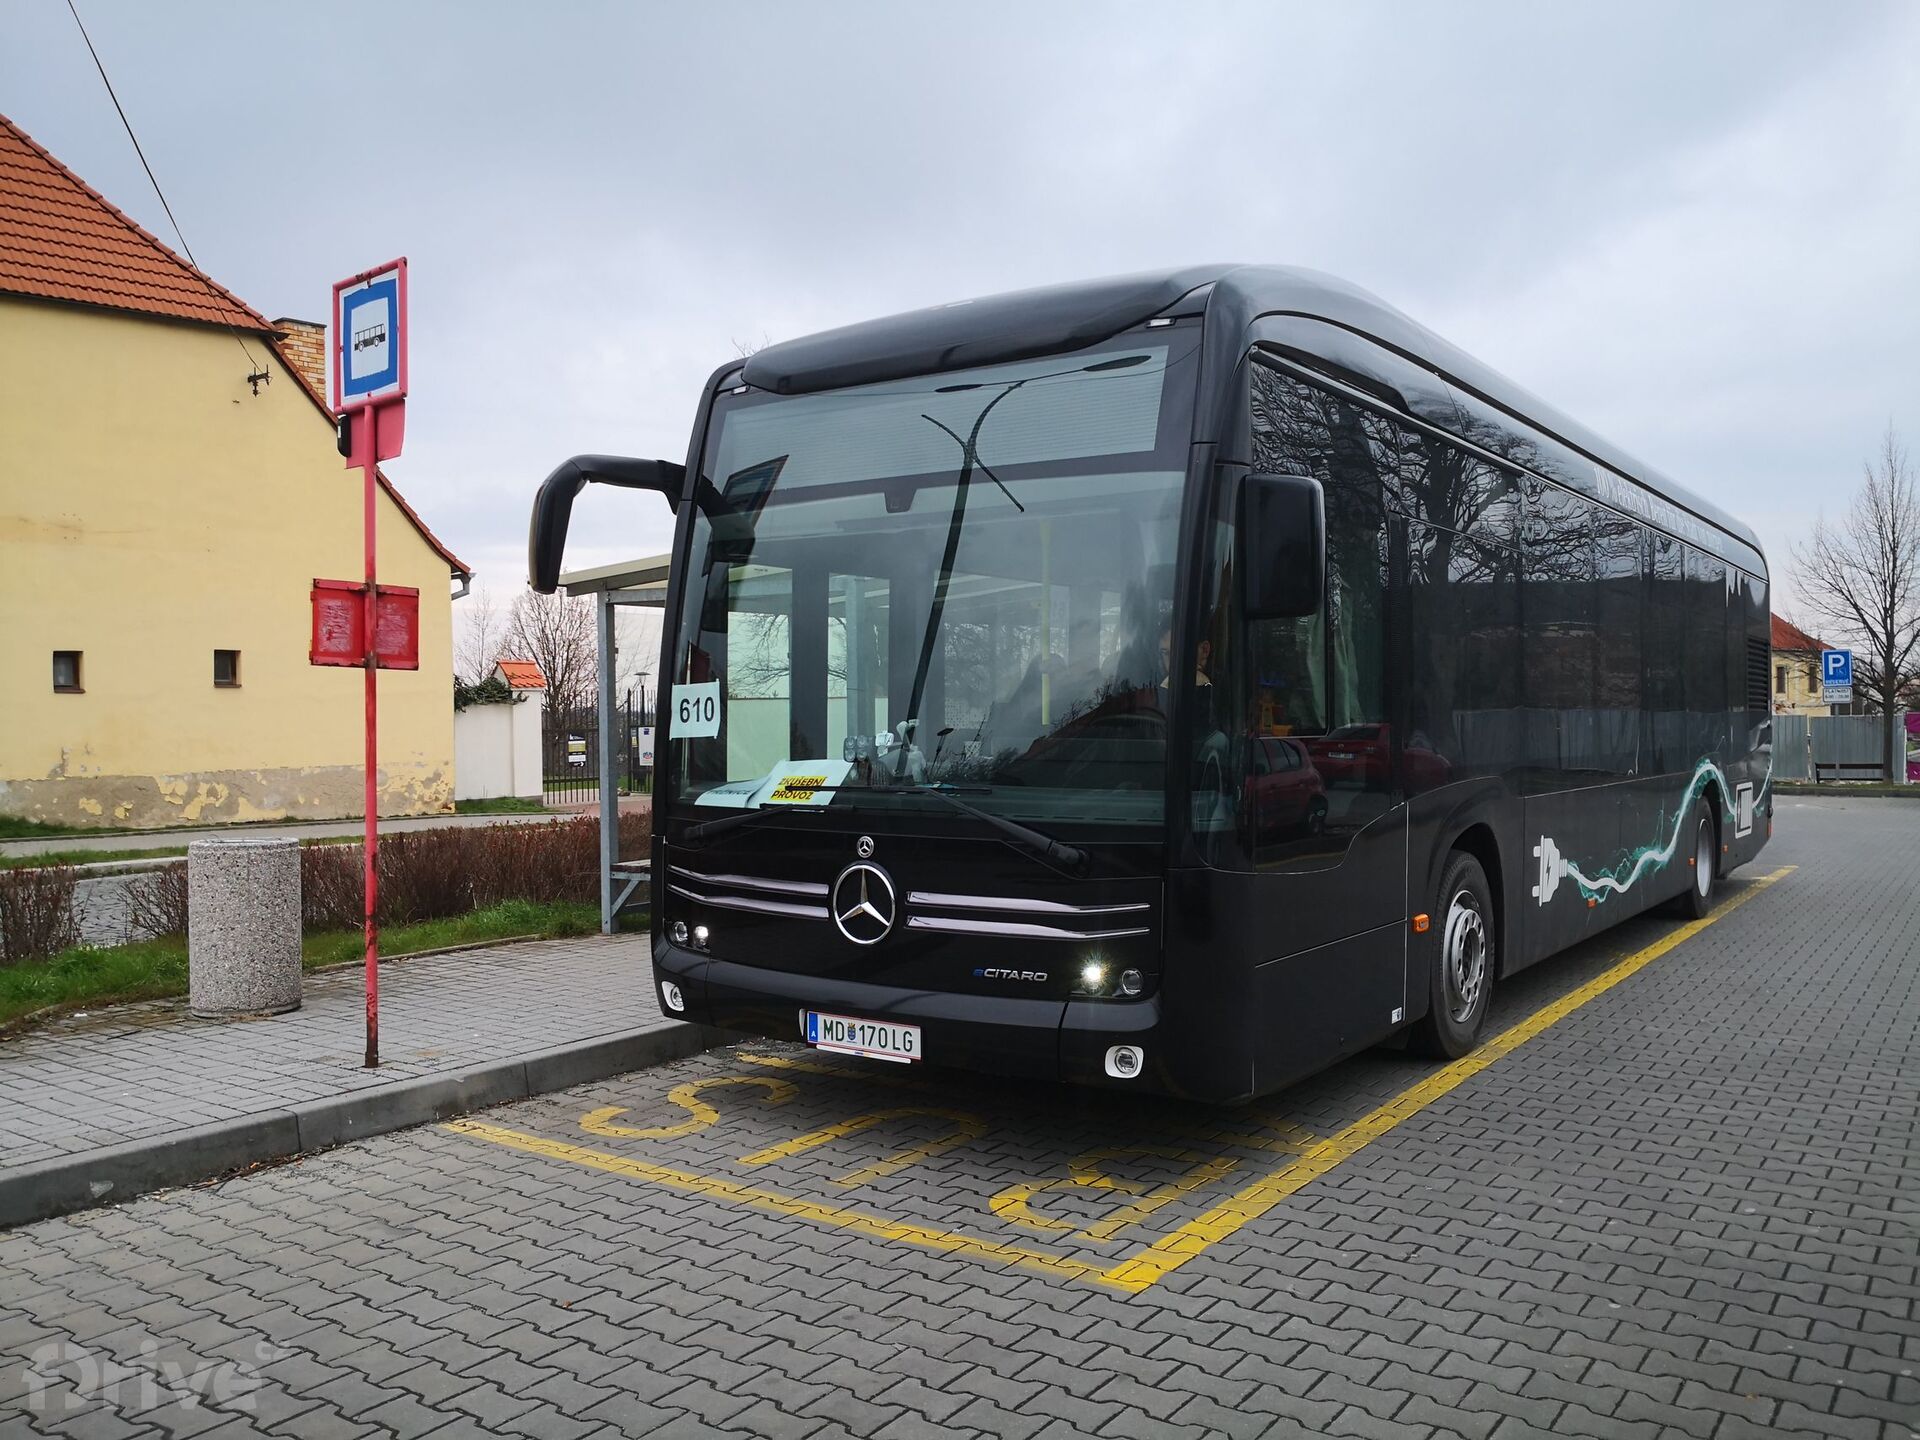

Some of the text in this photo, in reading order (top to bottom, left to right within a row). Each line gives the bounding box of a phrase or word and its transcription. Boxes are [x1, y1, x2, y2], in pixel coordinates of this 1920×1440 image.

[1828, 654, 1845, 676] P
[679, 696, 716, 723] 610
[771, 789, 814, 800] PROVOZ
[823, 1018, 845, 1042] MD
